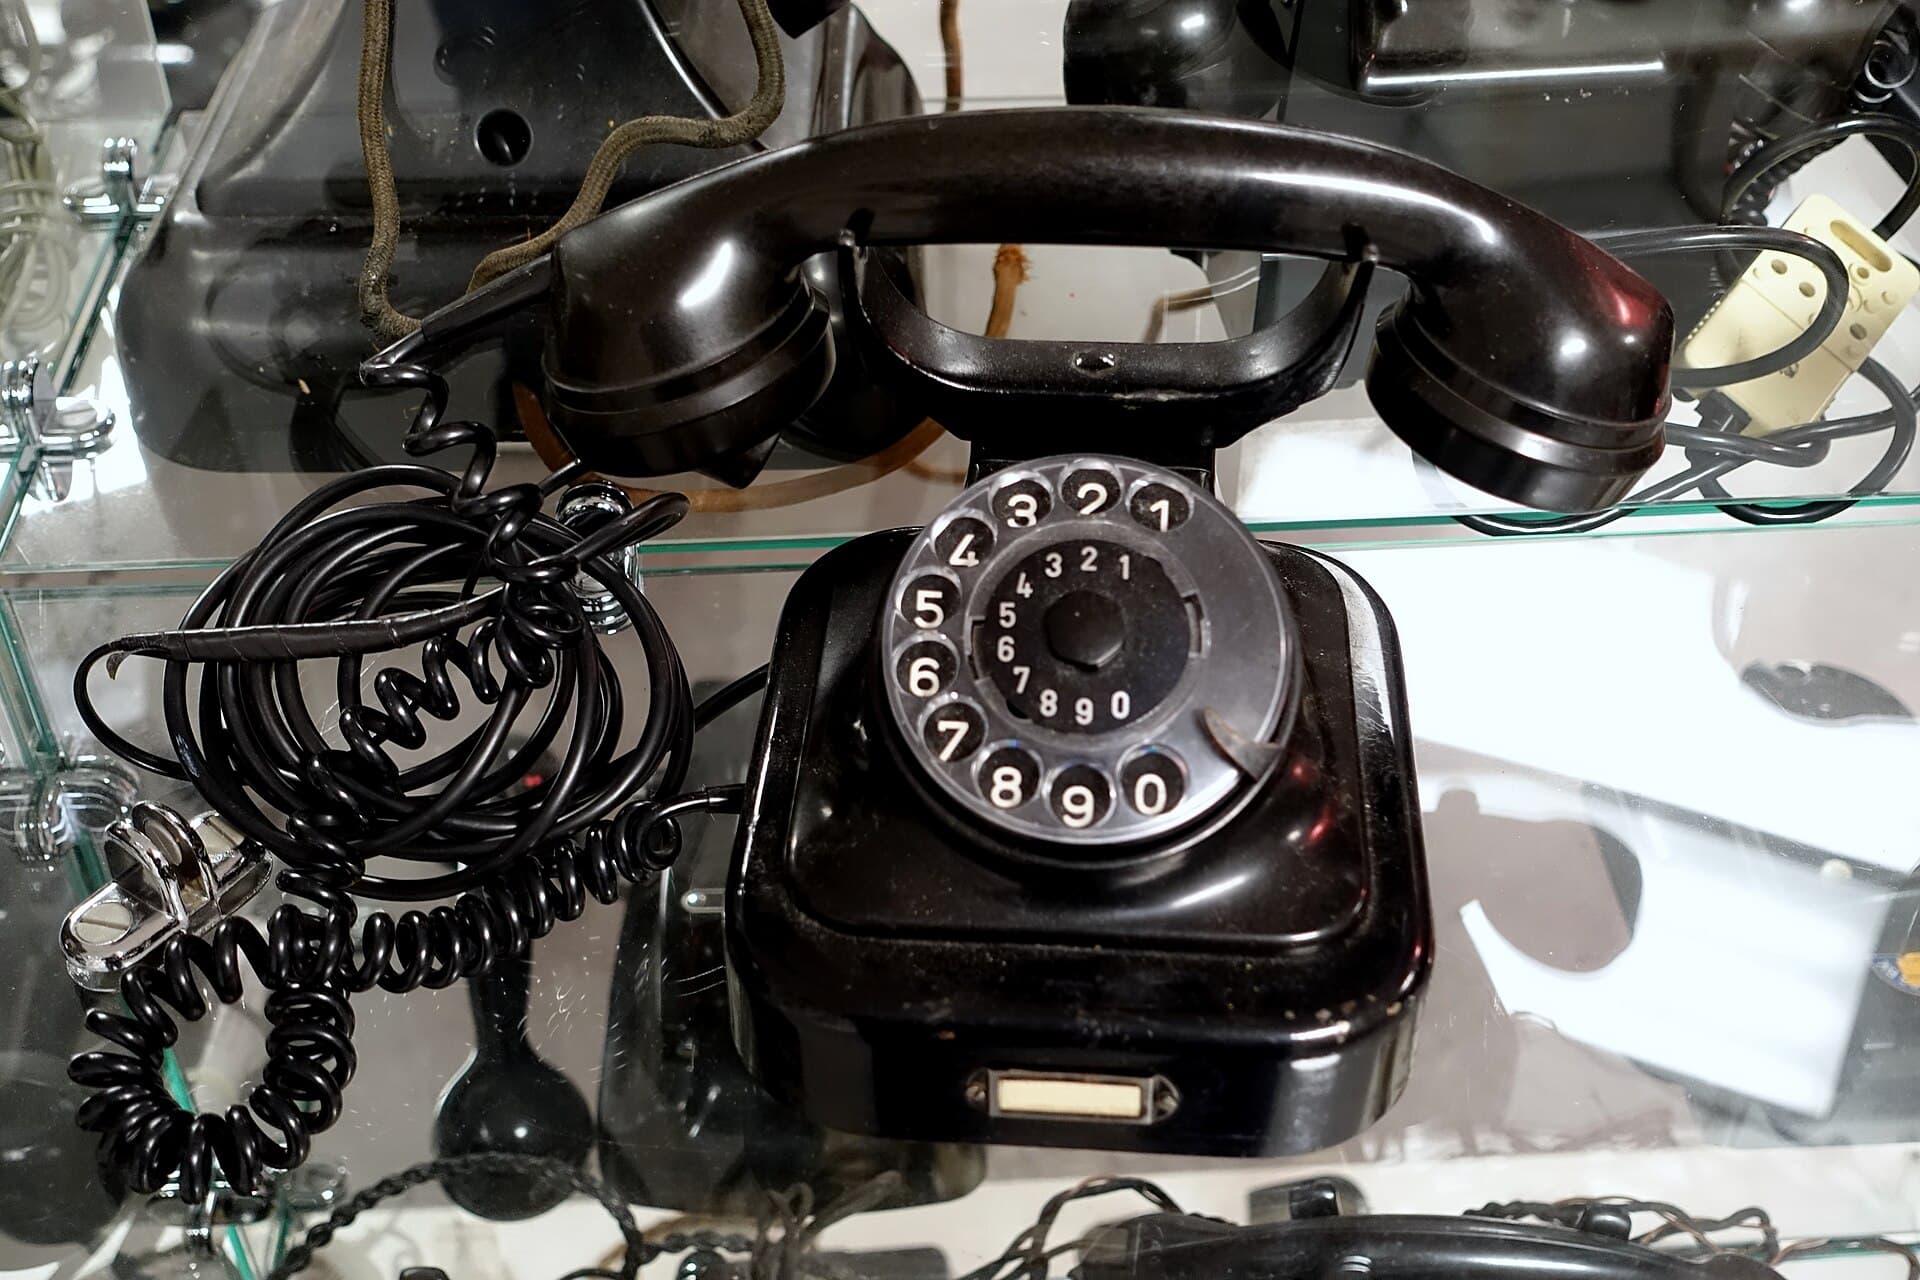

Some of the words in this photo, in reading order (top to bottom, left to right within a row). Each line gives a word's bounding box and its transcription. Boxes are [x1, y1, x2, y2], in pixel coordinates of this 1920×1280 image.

[1008, 494, 1037, 527] 3
[1078, 483, 1107, 515] 2
[1150, 500, 1169, 532] 1
[949, 534, 979, 566] 4
[1045, 553, 1062, 578] 3
[1081, 546, 1098, 571] 2
[1119, 555, 1129, 580] 1
[1017, 573, 1033, 598] 4
[915, 590, 943, 628] 5
[1000, 602, 1016, 628] 5
[998, 636, 1014, 662] 6
[910, 658, 939, 696] 6
[1013, 666, 1030, 693] 7
[1040, 689, 1058, 717] 8
[1075, 698, 1094, 725] 9
[1111, 690, 1130, 720] 0
[938, 721, 968, 761] 7
[991, 767, 1021, 807] 8
[1133, 774, 1168, 816] 0
[1063, 786, 1093, 827] 9
